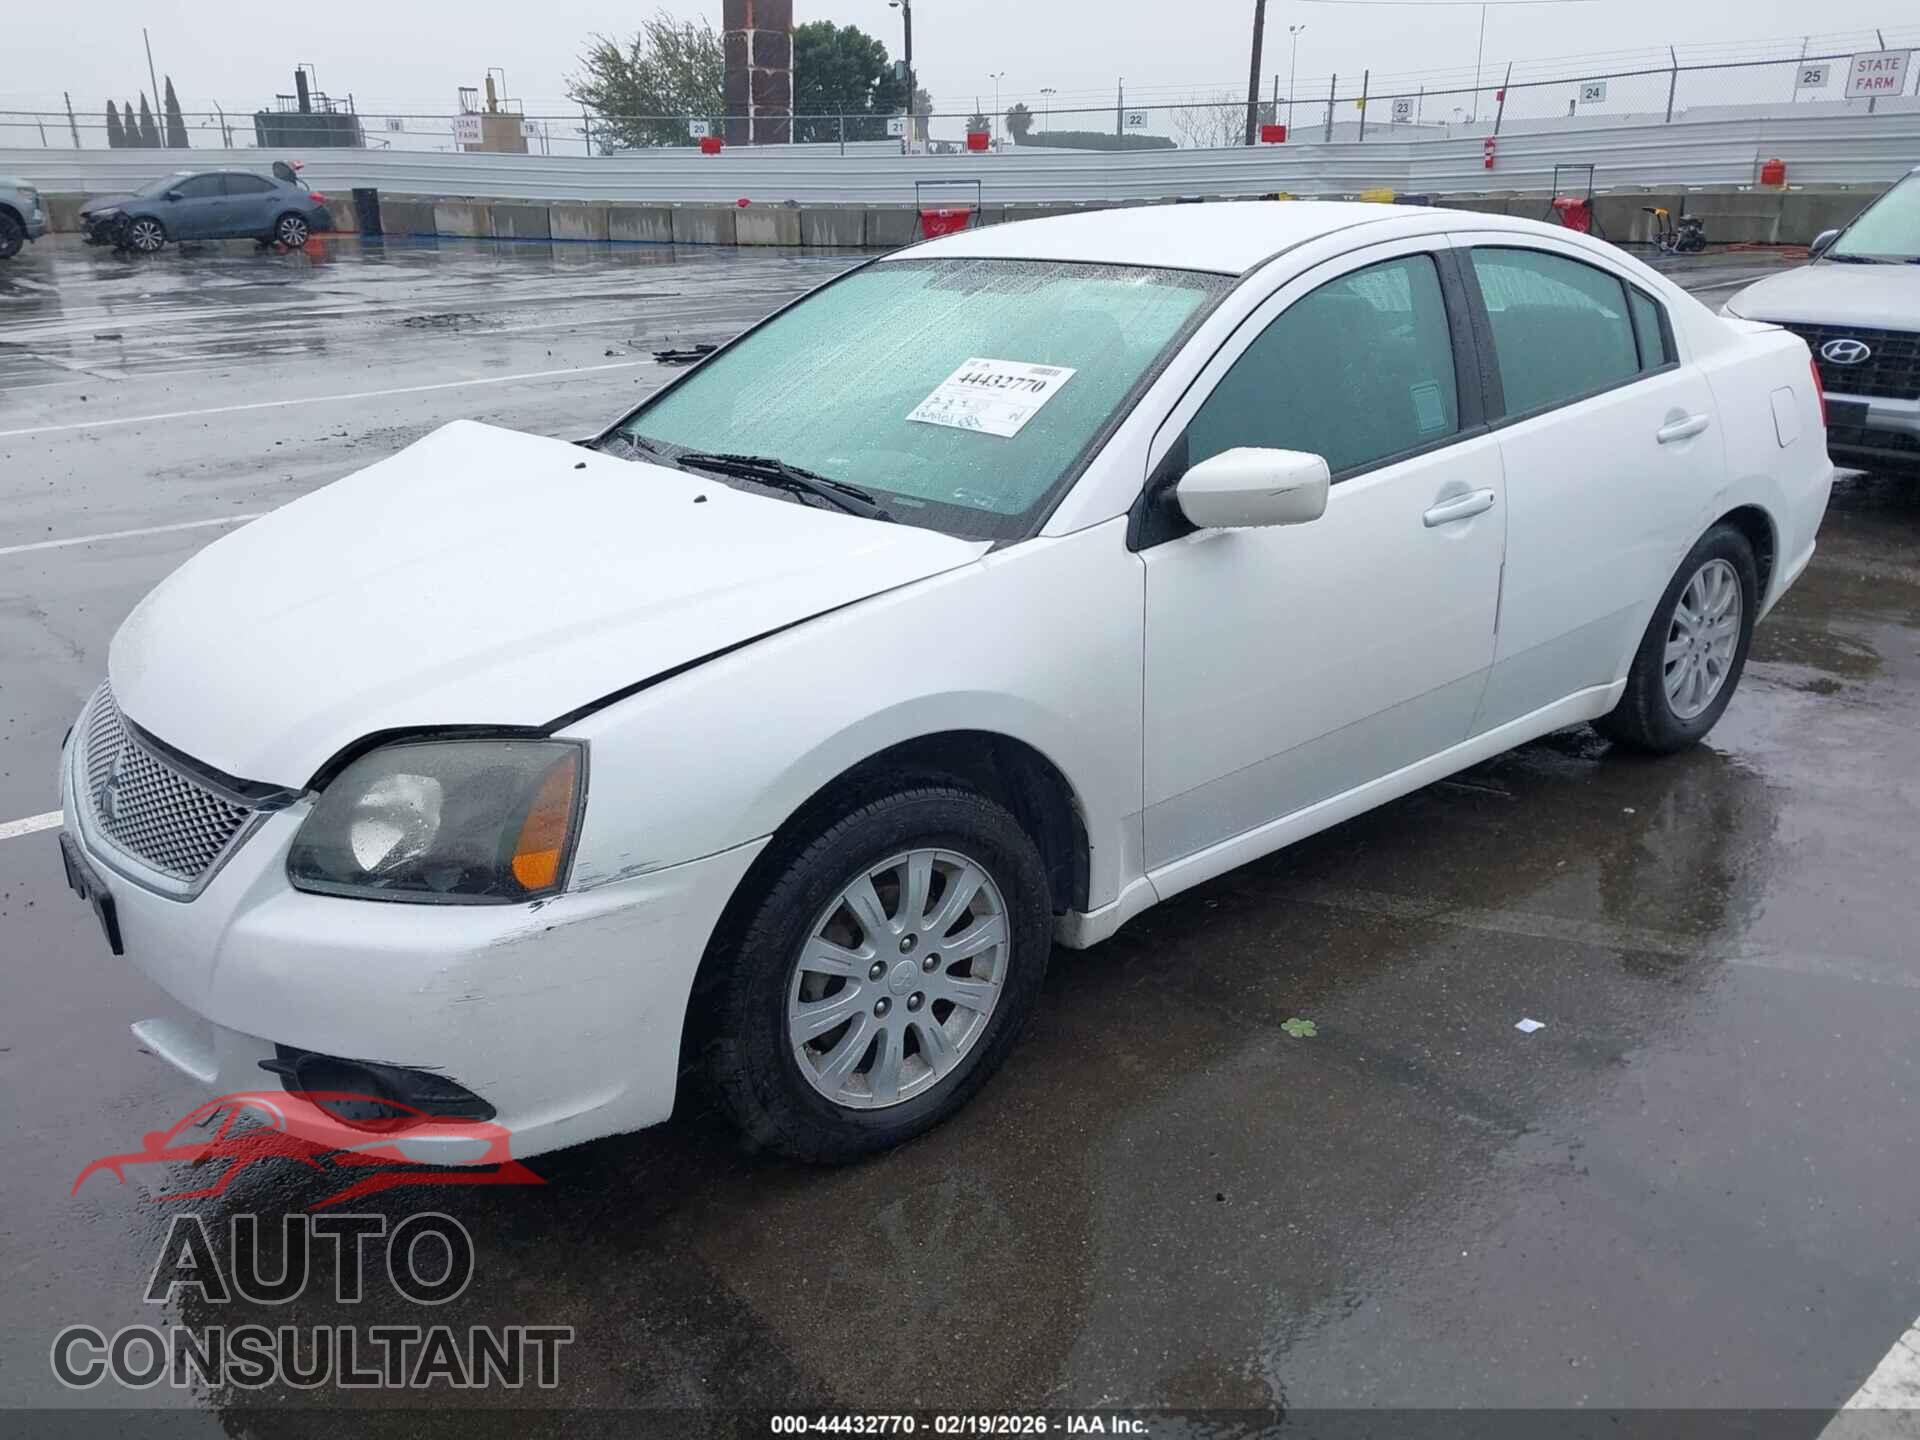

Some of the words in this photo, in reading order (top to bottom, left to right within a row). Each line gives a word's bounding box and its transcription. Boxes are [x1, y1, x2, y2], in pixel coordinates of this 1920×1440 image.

[1858, 58, 1901, 72] STATE
[1804, 71, 1821, 83] 25
[1856, 77, 1895, 90] FARM
[1586, 88, 1600, 99] 24
[1397, 103, 1409, 113] 23
[1129, 115, 1142, 125] 22
[694, 124, 704, 133] 20
[893, 123, 904, 131] 21
[958, 371, 1047, 393] 44432770
